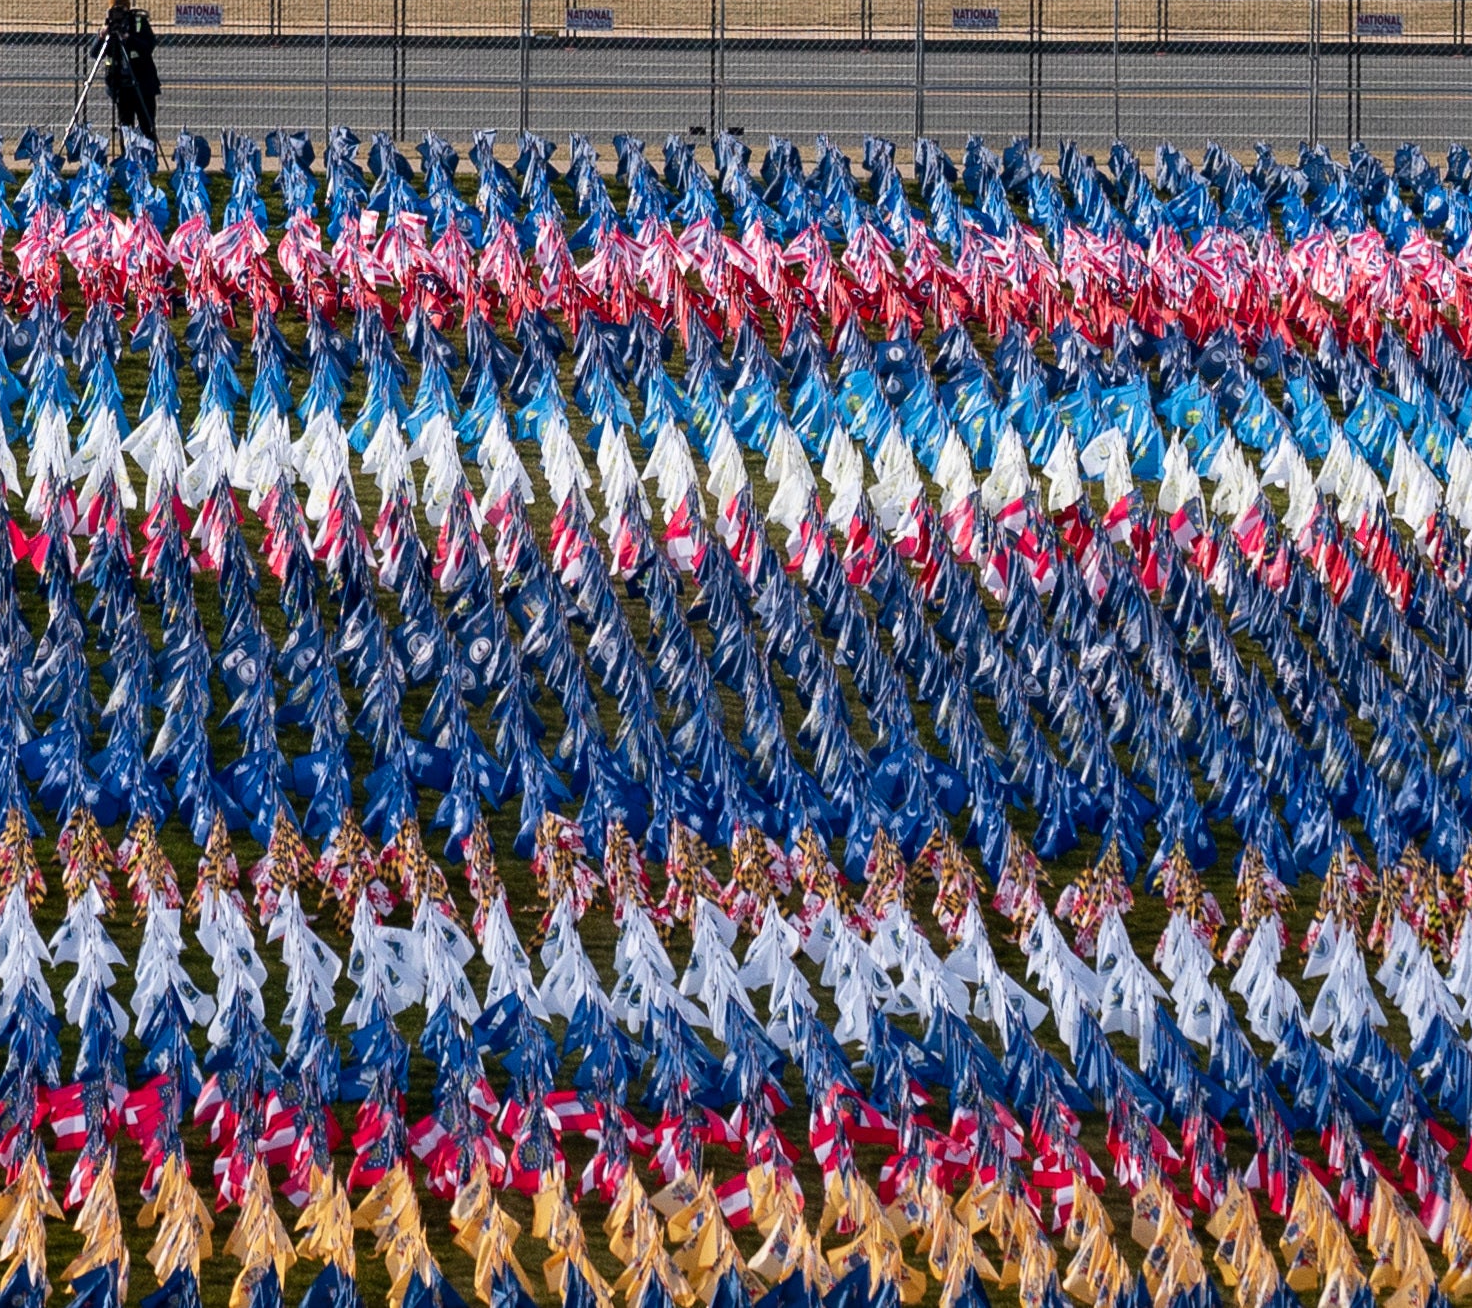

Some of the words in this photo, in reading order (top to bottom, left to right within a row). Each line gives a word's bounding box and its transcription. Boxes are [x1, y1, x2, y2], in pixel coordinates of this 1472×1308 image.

[176, 5, 221, 15] NATIONAL
[567, 9, 612, 19] NATIONAL
[953, 8, 998, 19] NATIONAL
[1357, 15, 1402, 25] NATIONAL
